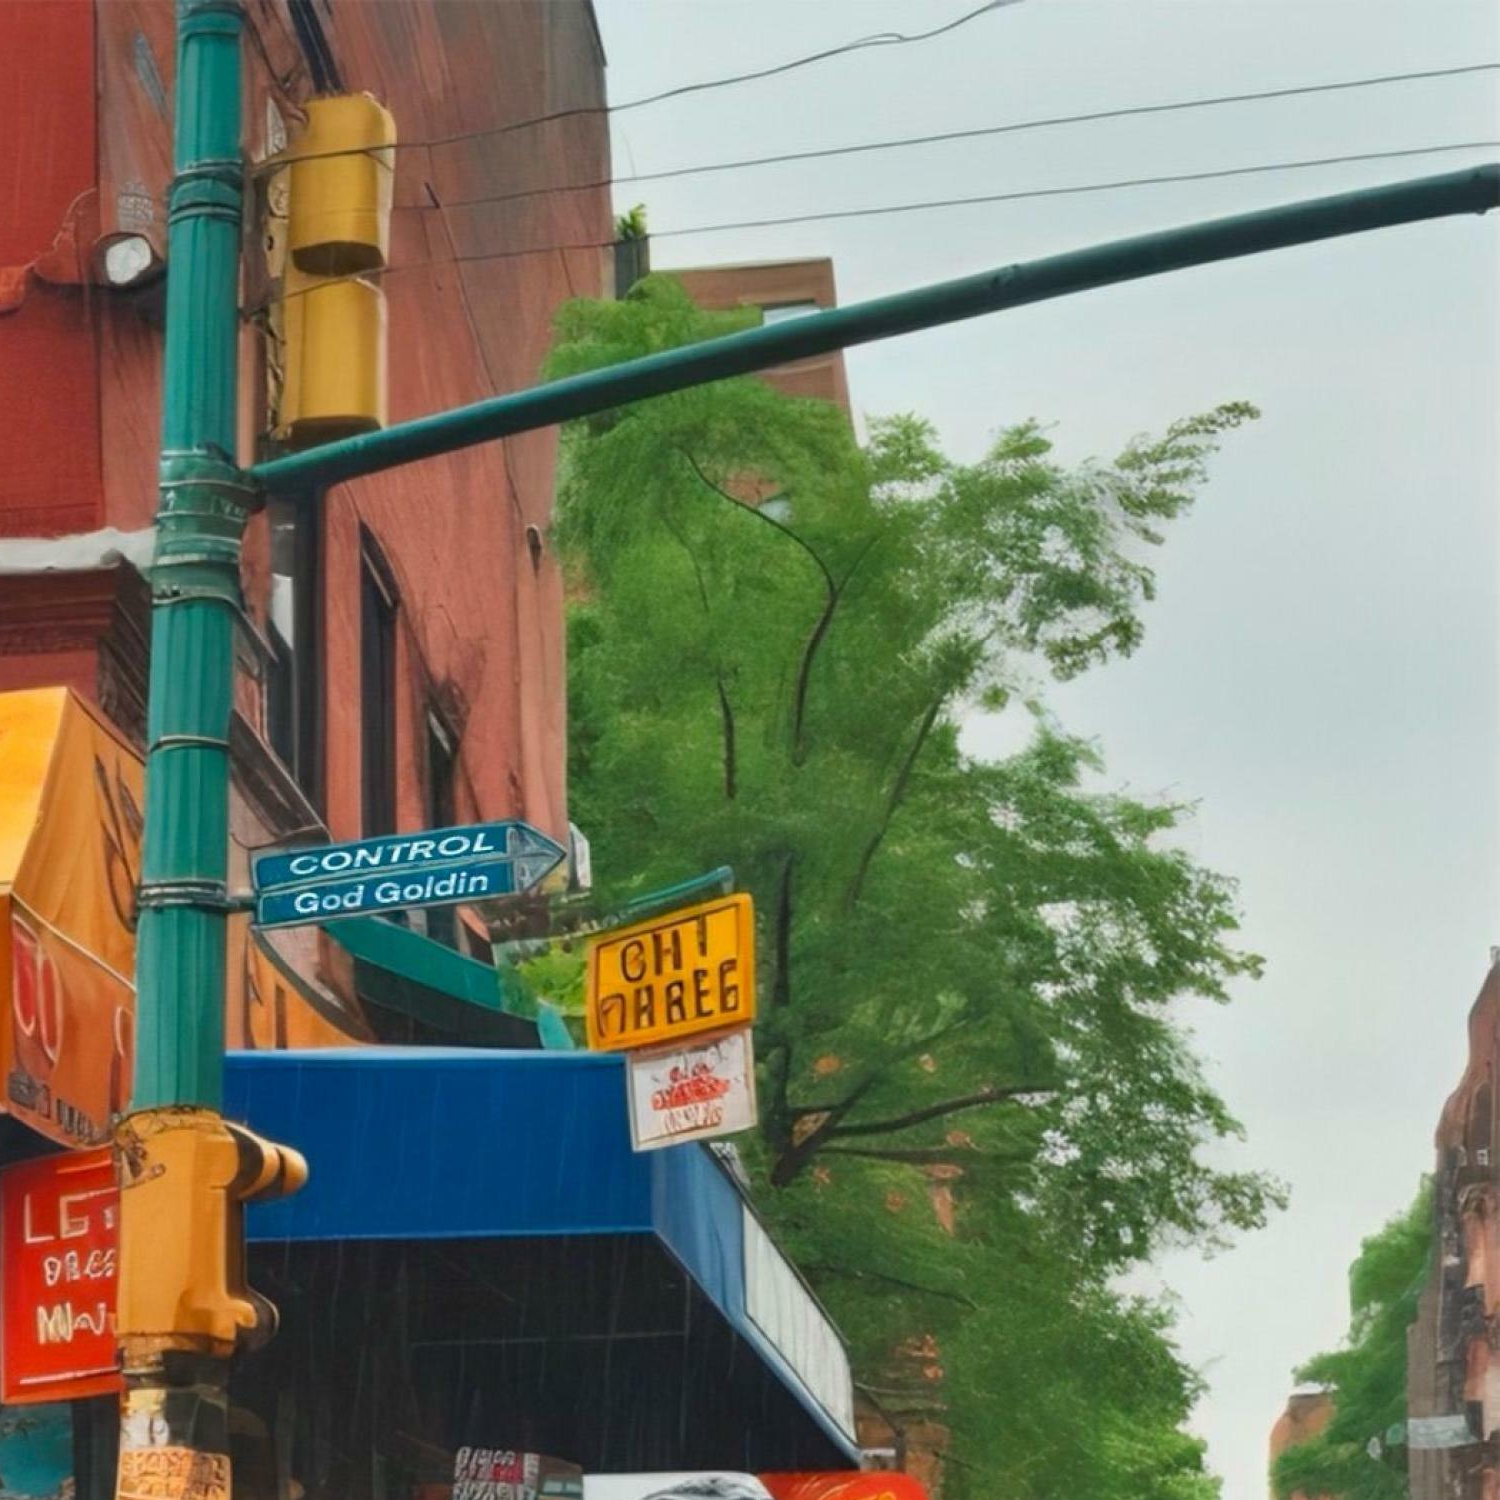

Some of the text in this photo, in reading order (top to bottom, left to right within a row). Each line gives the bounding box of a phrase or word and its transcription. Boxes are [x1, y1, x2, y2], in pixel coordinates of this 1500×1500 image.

[289, 832, 495, 875] CONTROL
[293, 871, 489, 914] God Goldin
